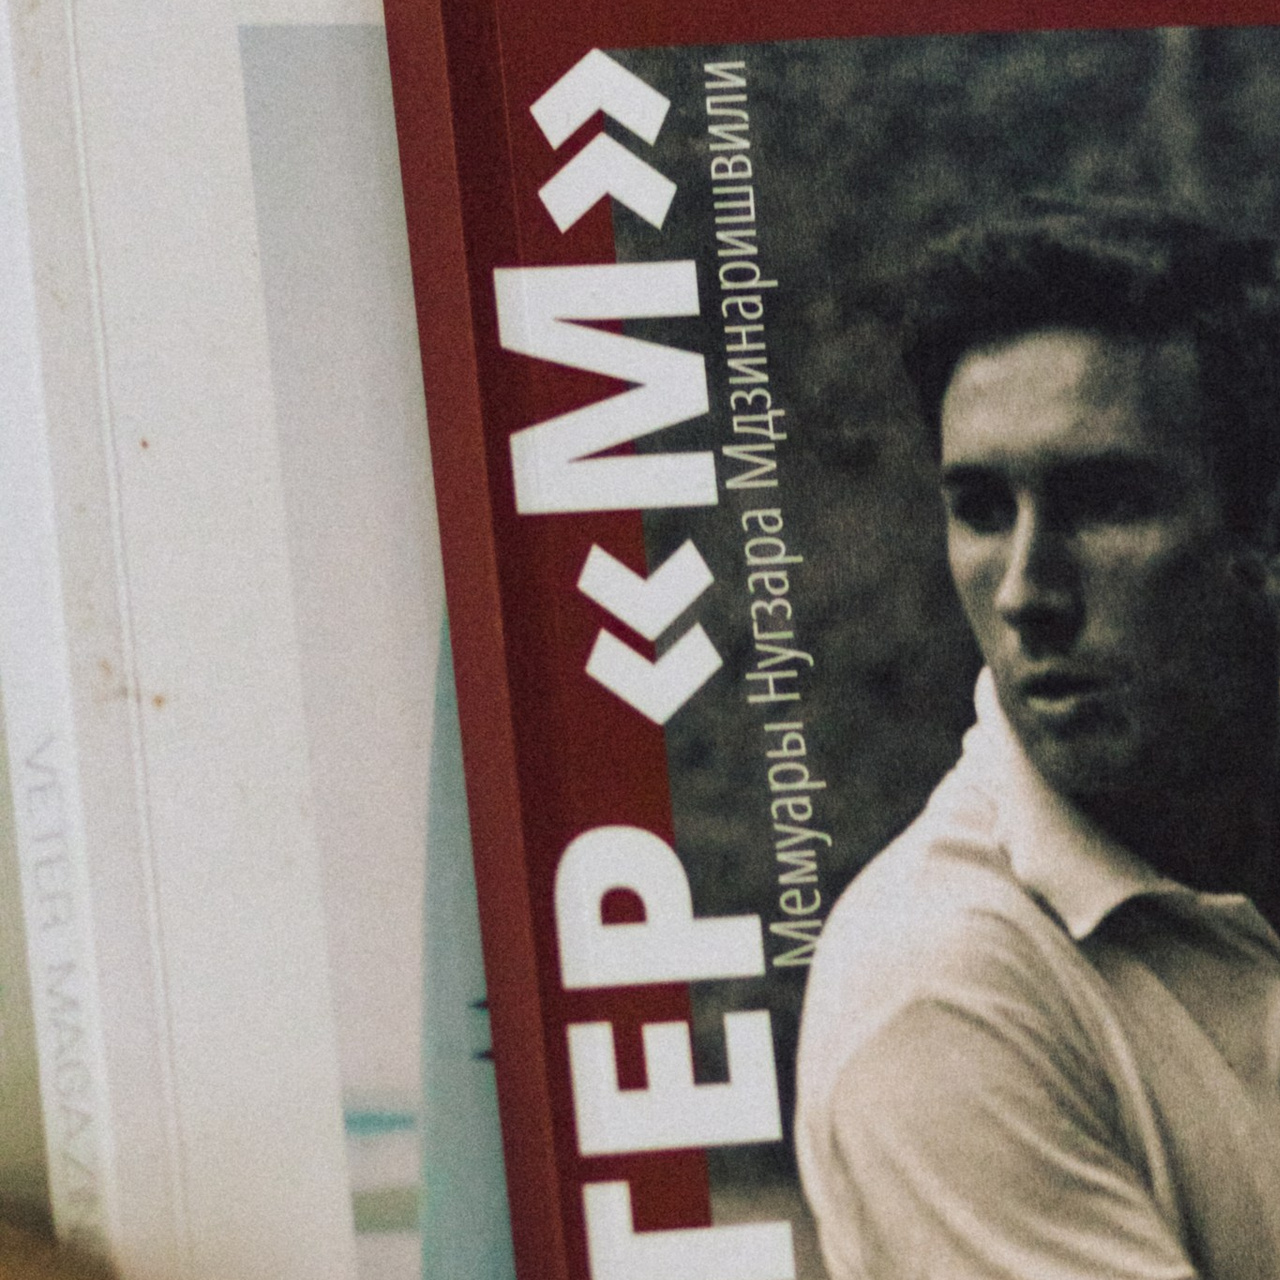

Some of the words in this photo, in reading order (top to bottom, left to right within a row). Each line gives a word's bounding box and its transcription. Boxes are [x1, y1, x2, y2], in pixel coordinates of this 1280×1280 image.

[493, 48, 723, 726] «М»
[703, 60, 788, 490] Мдзинаришвили
[741, 508, 815, 705] Нугзара
[768, 722, 833, 969] Мемуары
